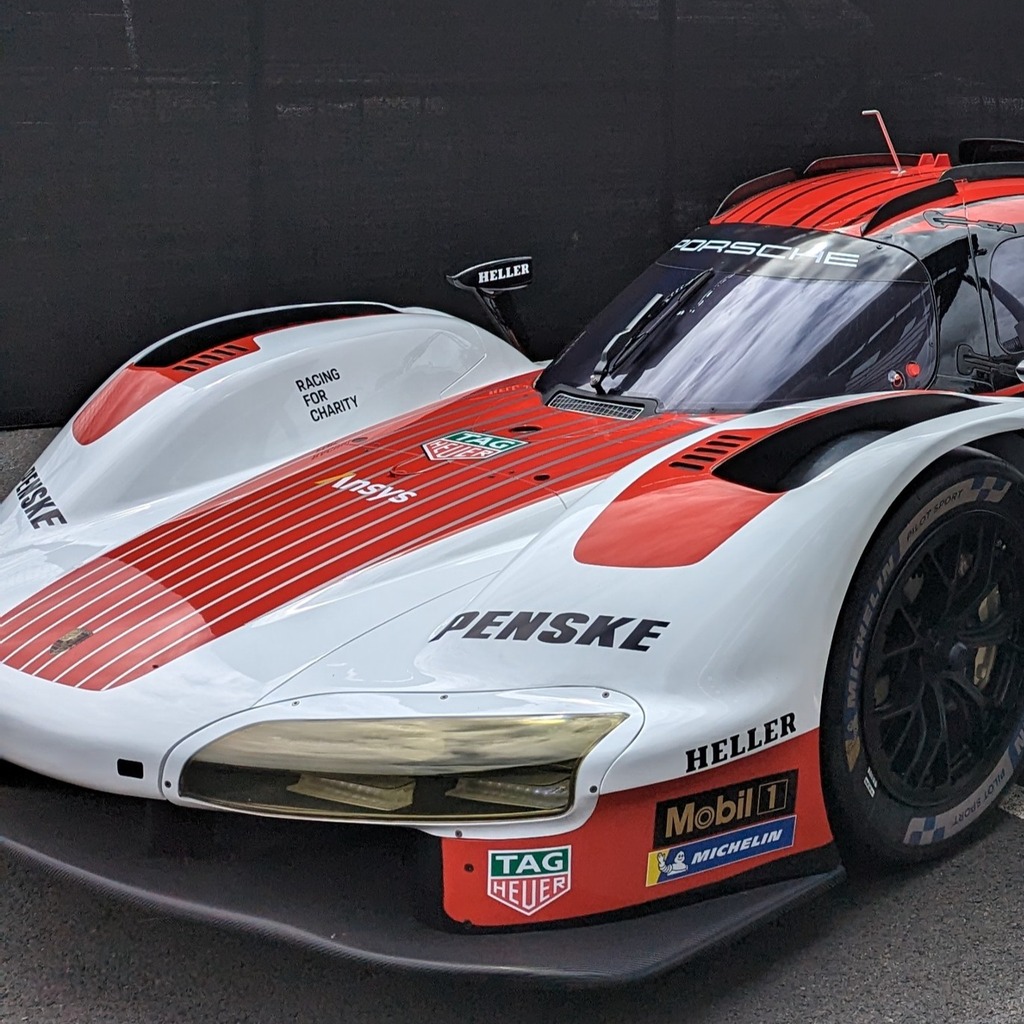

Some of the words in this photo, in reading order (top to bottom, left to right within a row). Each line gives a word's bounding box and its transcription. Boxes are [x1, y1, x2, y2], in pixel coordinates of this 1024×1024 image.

[670, 238, 860, 268] PORSCHE
[478, 263, 530, 284] HELLER
[295, 368, 341, 392] RACING
[302, 389, 329, 407] FOR
[310, 395, 358, 422] CHARITY
[430, 440, 495, 458] HEUER
[457, 433, 515, 450] TAG
[314, 470, 418, 504] Ansys
[905, 508, 932, 542] PILOT
[933, 488, 964, 513] SPORT
[427, 611, 671, 652] PENSKE
[846, 554, 895, 709] MICHELIN
[686, 712, 797, 773] HELLER
[983, 768, 1006, 802] PILOT
[665, 786, 753, 839] Mobil
[952, 797, 983, 825] SPORT
[691, 829, 783, 865] MICHELIN
[495, 852, 564, 875] TAG
[493, 876, 566, 910] HEUER
